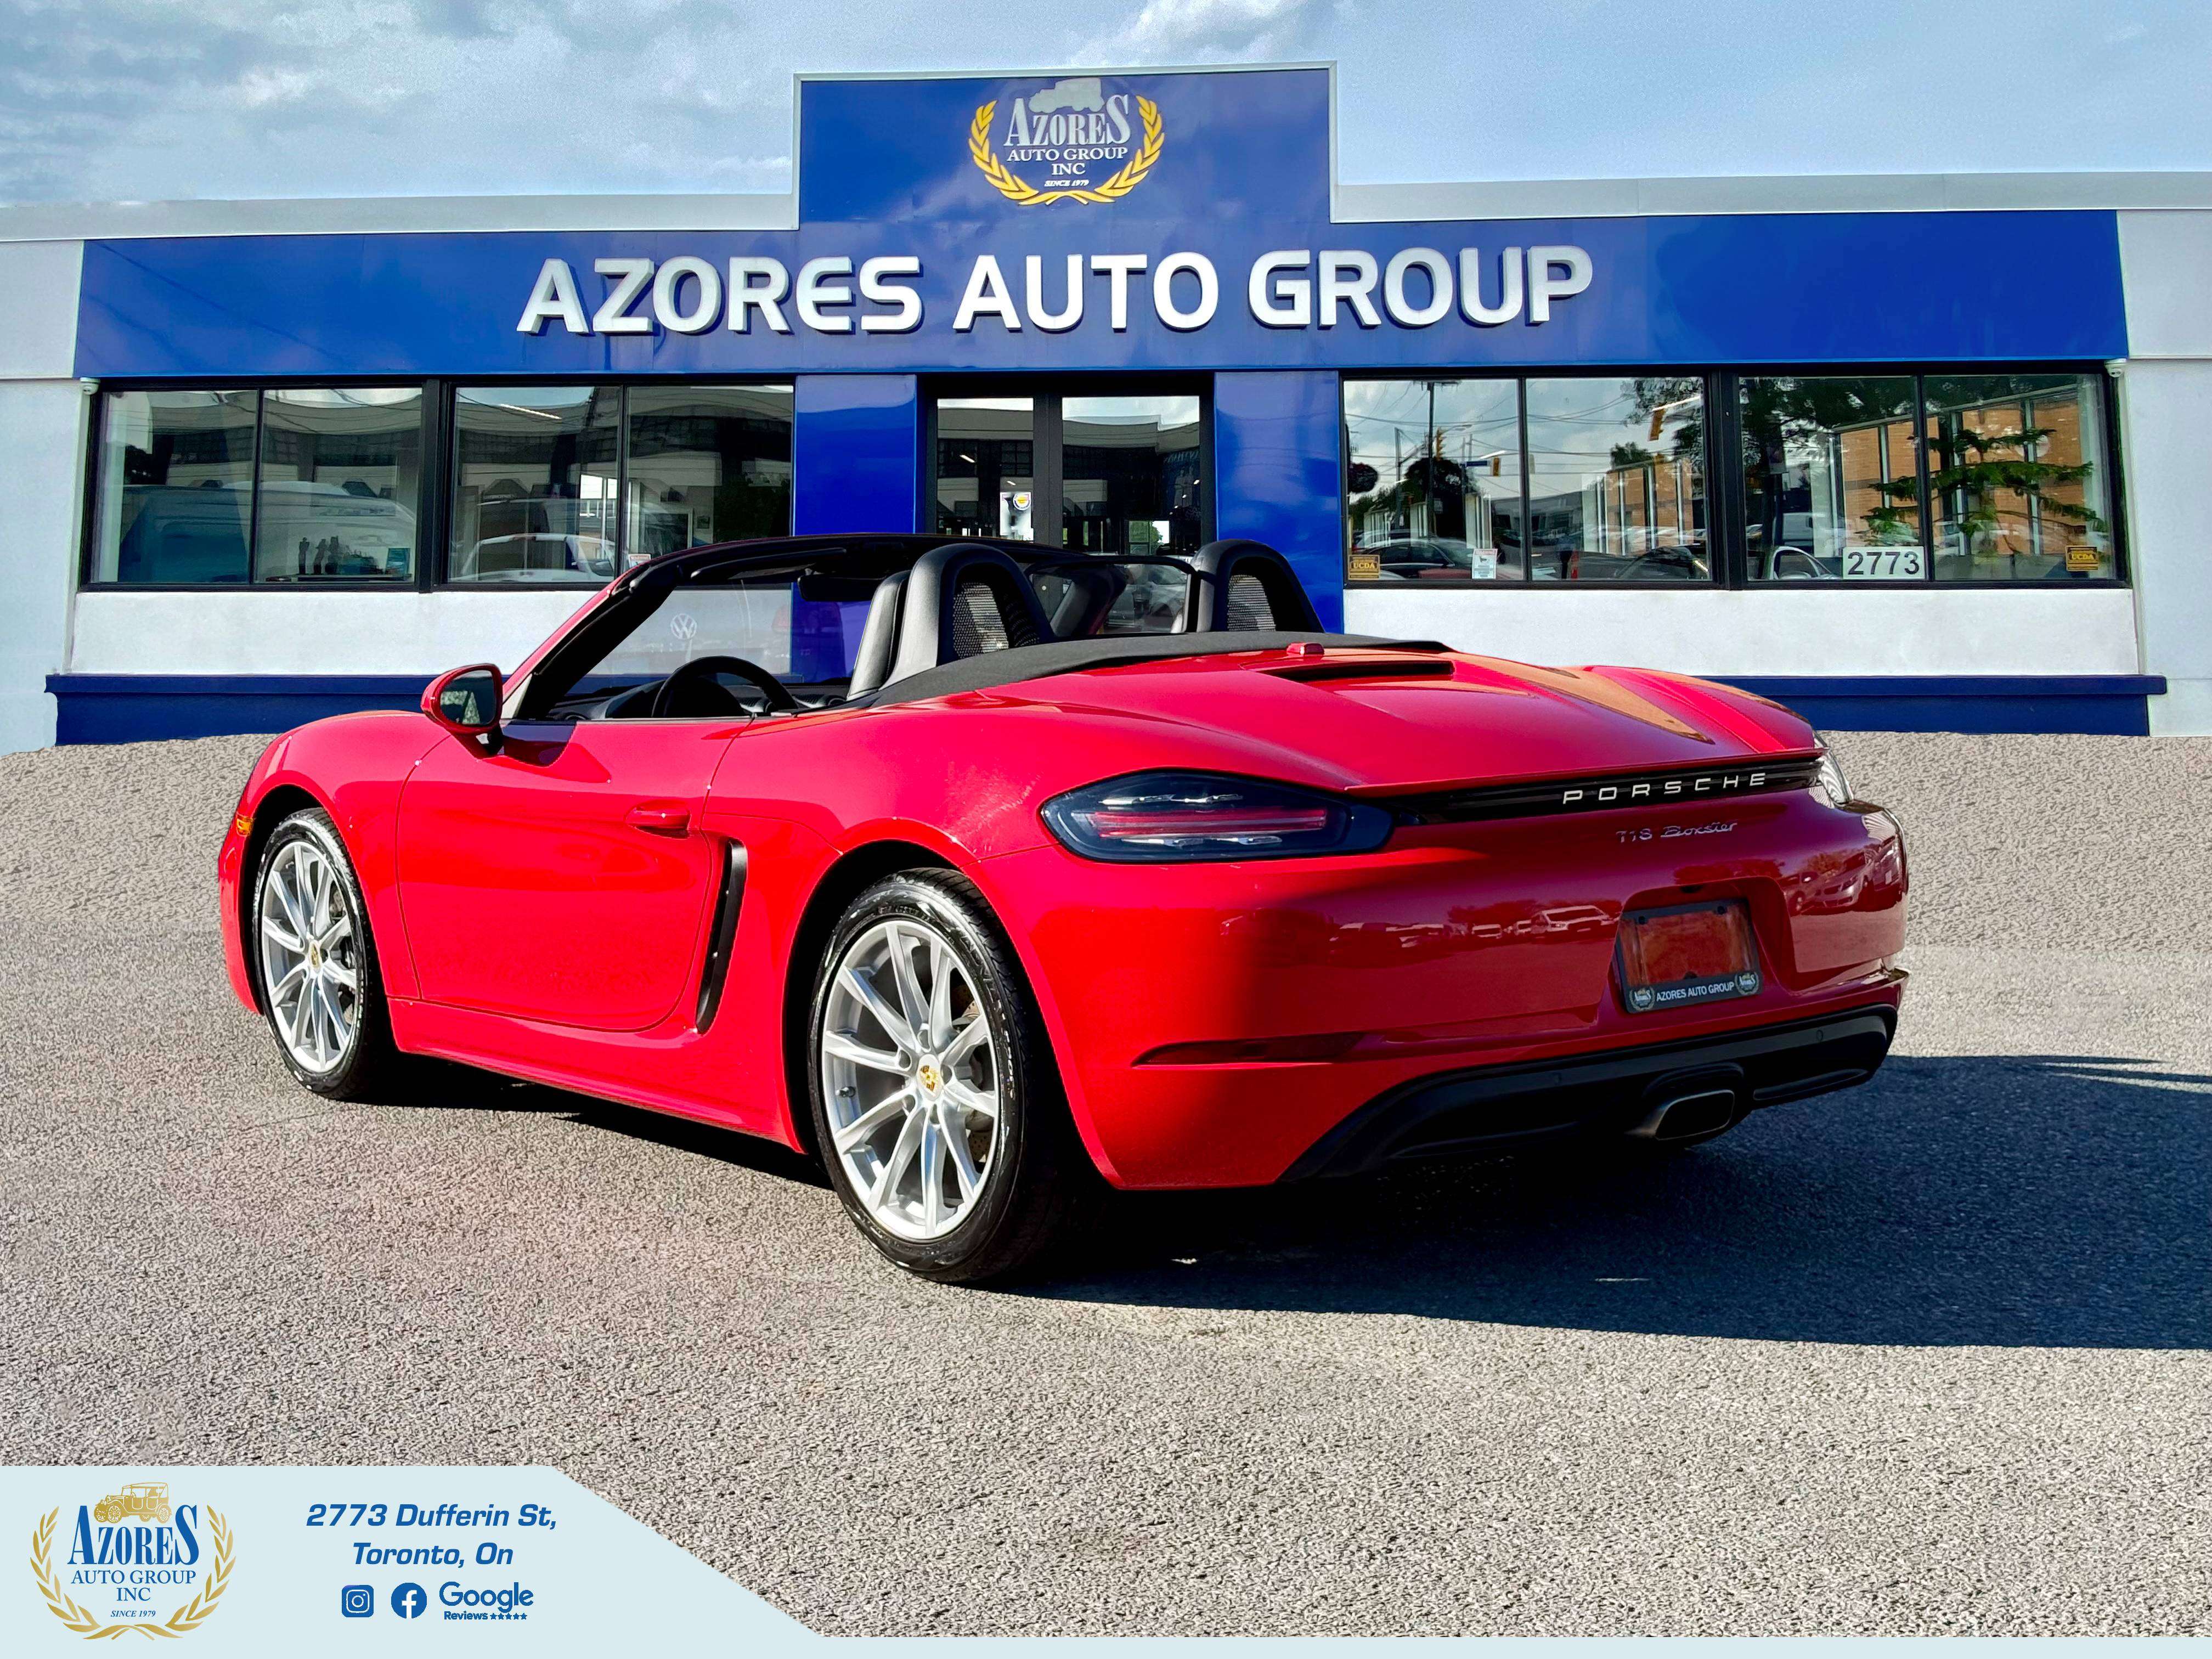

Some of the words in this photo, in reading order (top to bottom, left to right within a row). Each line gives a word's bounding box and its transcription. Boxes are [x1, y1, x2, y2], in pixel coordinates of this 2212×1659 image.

[1003, 94, 1131, 146] AZORES
[1007, 148, 1060, 162] AUTO
[1063, 146, 1128, 161] GROUP
[1051, 162, 1086, 175] INC
[517, 256, 924, 334] AZORES
[952, 251, 1218, 332] AUTO
[1248, 246, 1593, 329] GROUP
[1847, 551, 1920, 575] 2773
[1562, 772, 1765, 804] PORSCHE
[1656, 989, 1686, 1002] AZORES
[1688, 986, 1707, 997] AUTO
[1708, 981, 1734, 994] GROUP
